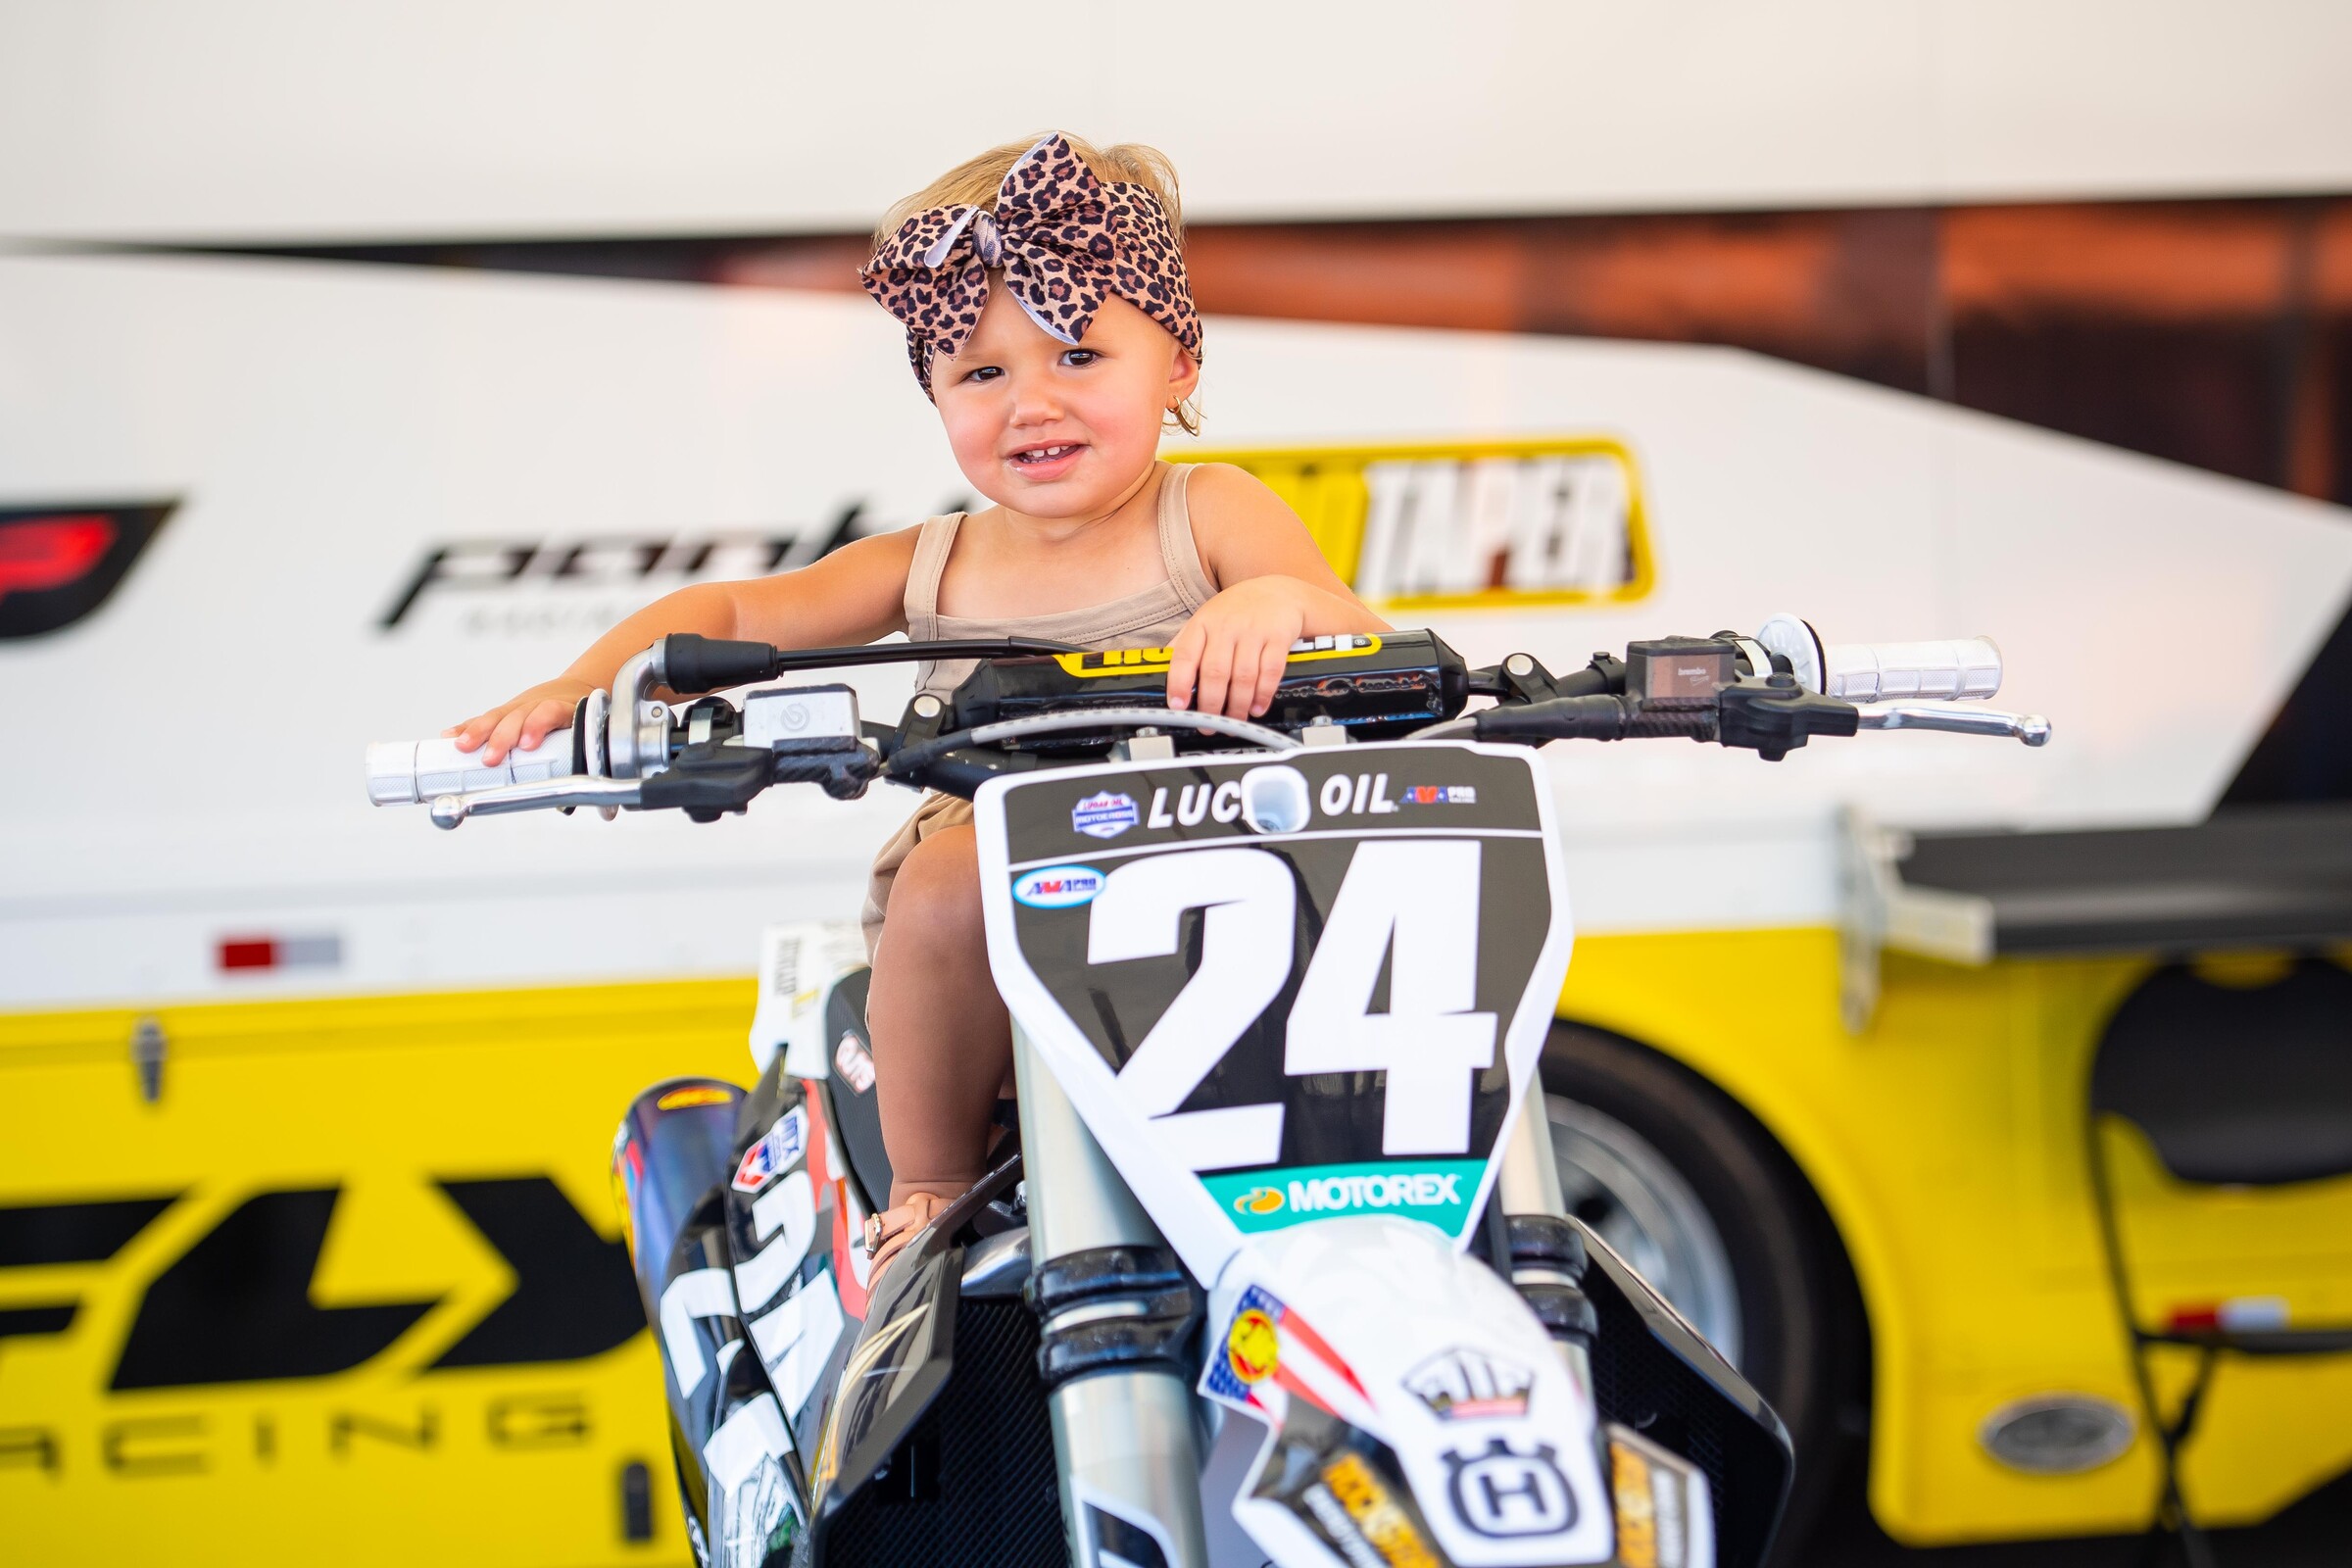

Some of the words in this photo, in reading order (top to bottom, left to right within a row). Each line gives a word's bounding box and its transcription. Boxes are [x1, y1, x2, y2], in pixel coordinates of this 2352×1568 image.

[1358, 455, 1633, 594] TAPER
[1148, 781, 1243, 829] LUC
[1088, 840, 1498, 1172] 24
[1289, 1174, 1461, 1212] MOTOREX
[0, 1396, 592, 1478] ACING
